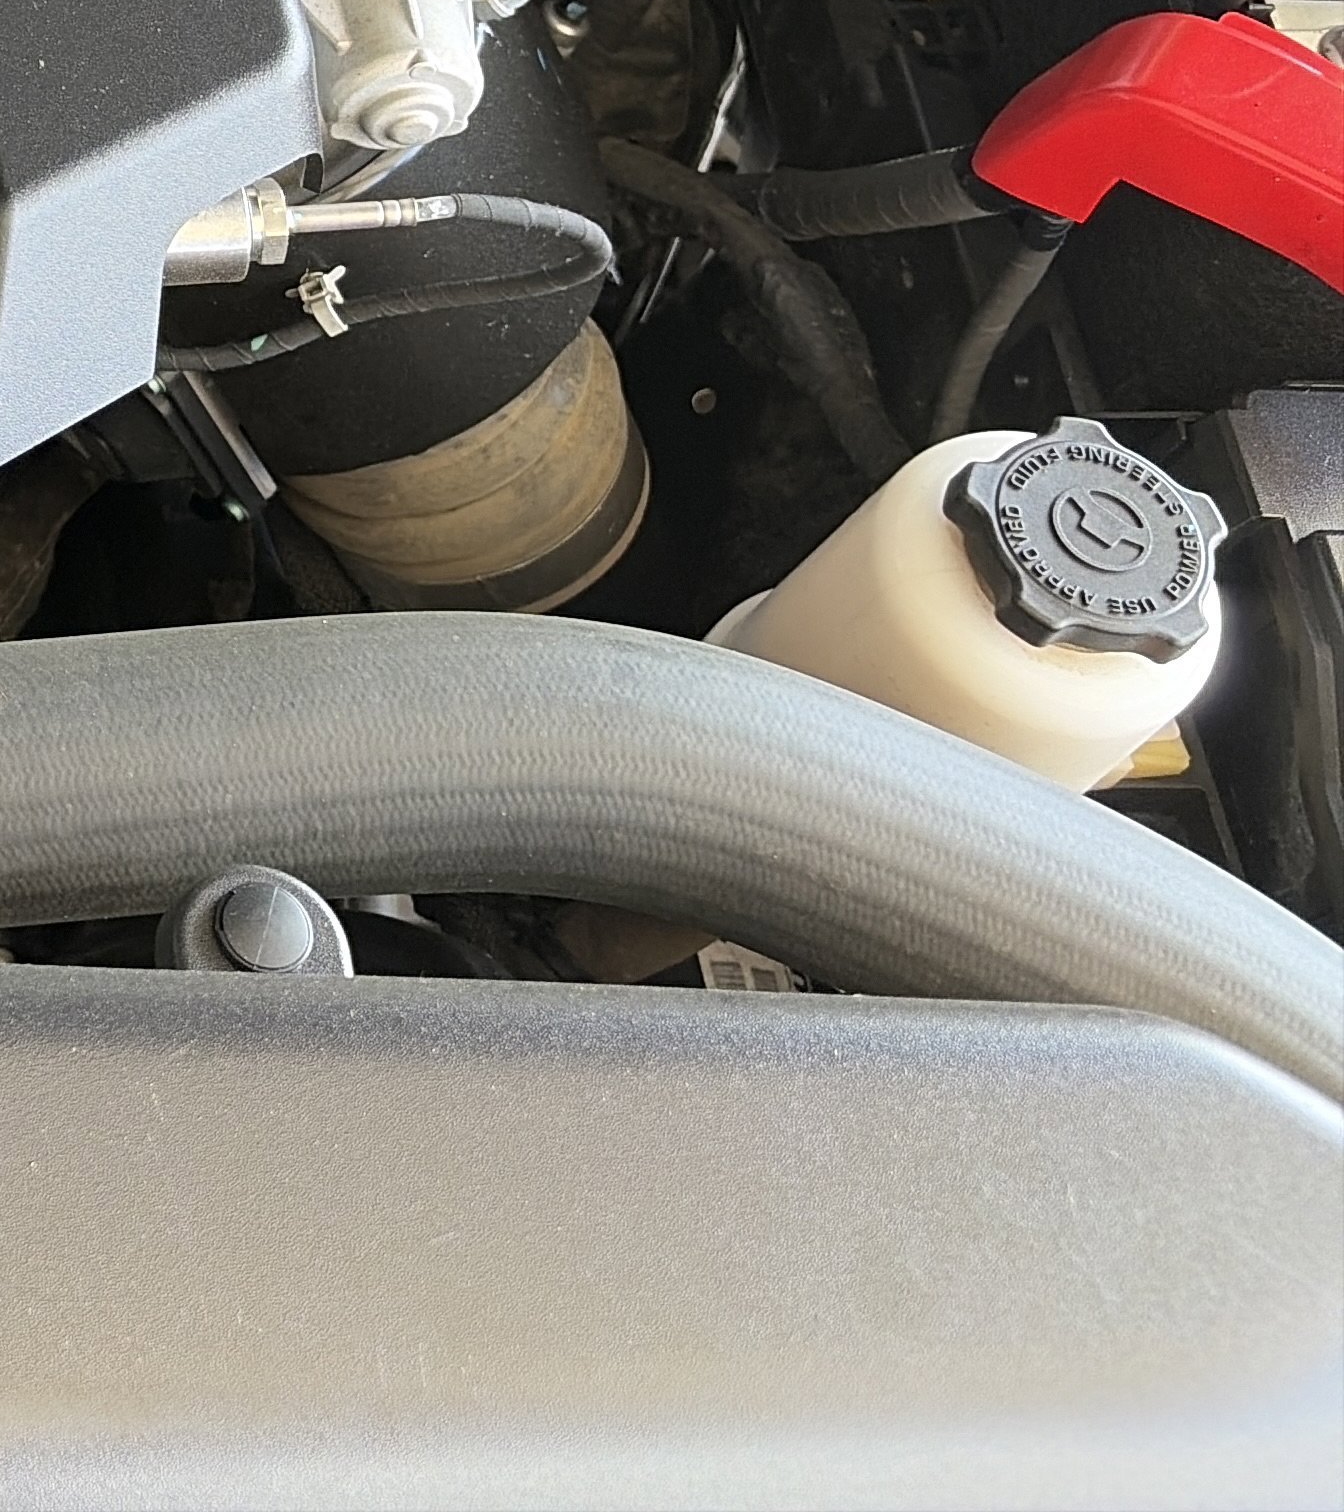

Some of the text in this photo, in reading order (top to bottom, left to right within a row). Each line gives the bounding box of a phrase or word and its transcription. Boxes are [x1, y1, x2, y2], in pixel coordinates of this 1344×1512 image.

[1002, 504, 1156, 614] USE APPROVED
[1010, 445, 1202, 601] POWER STEERING FLUID
